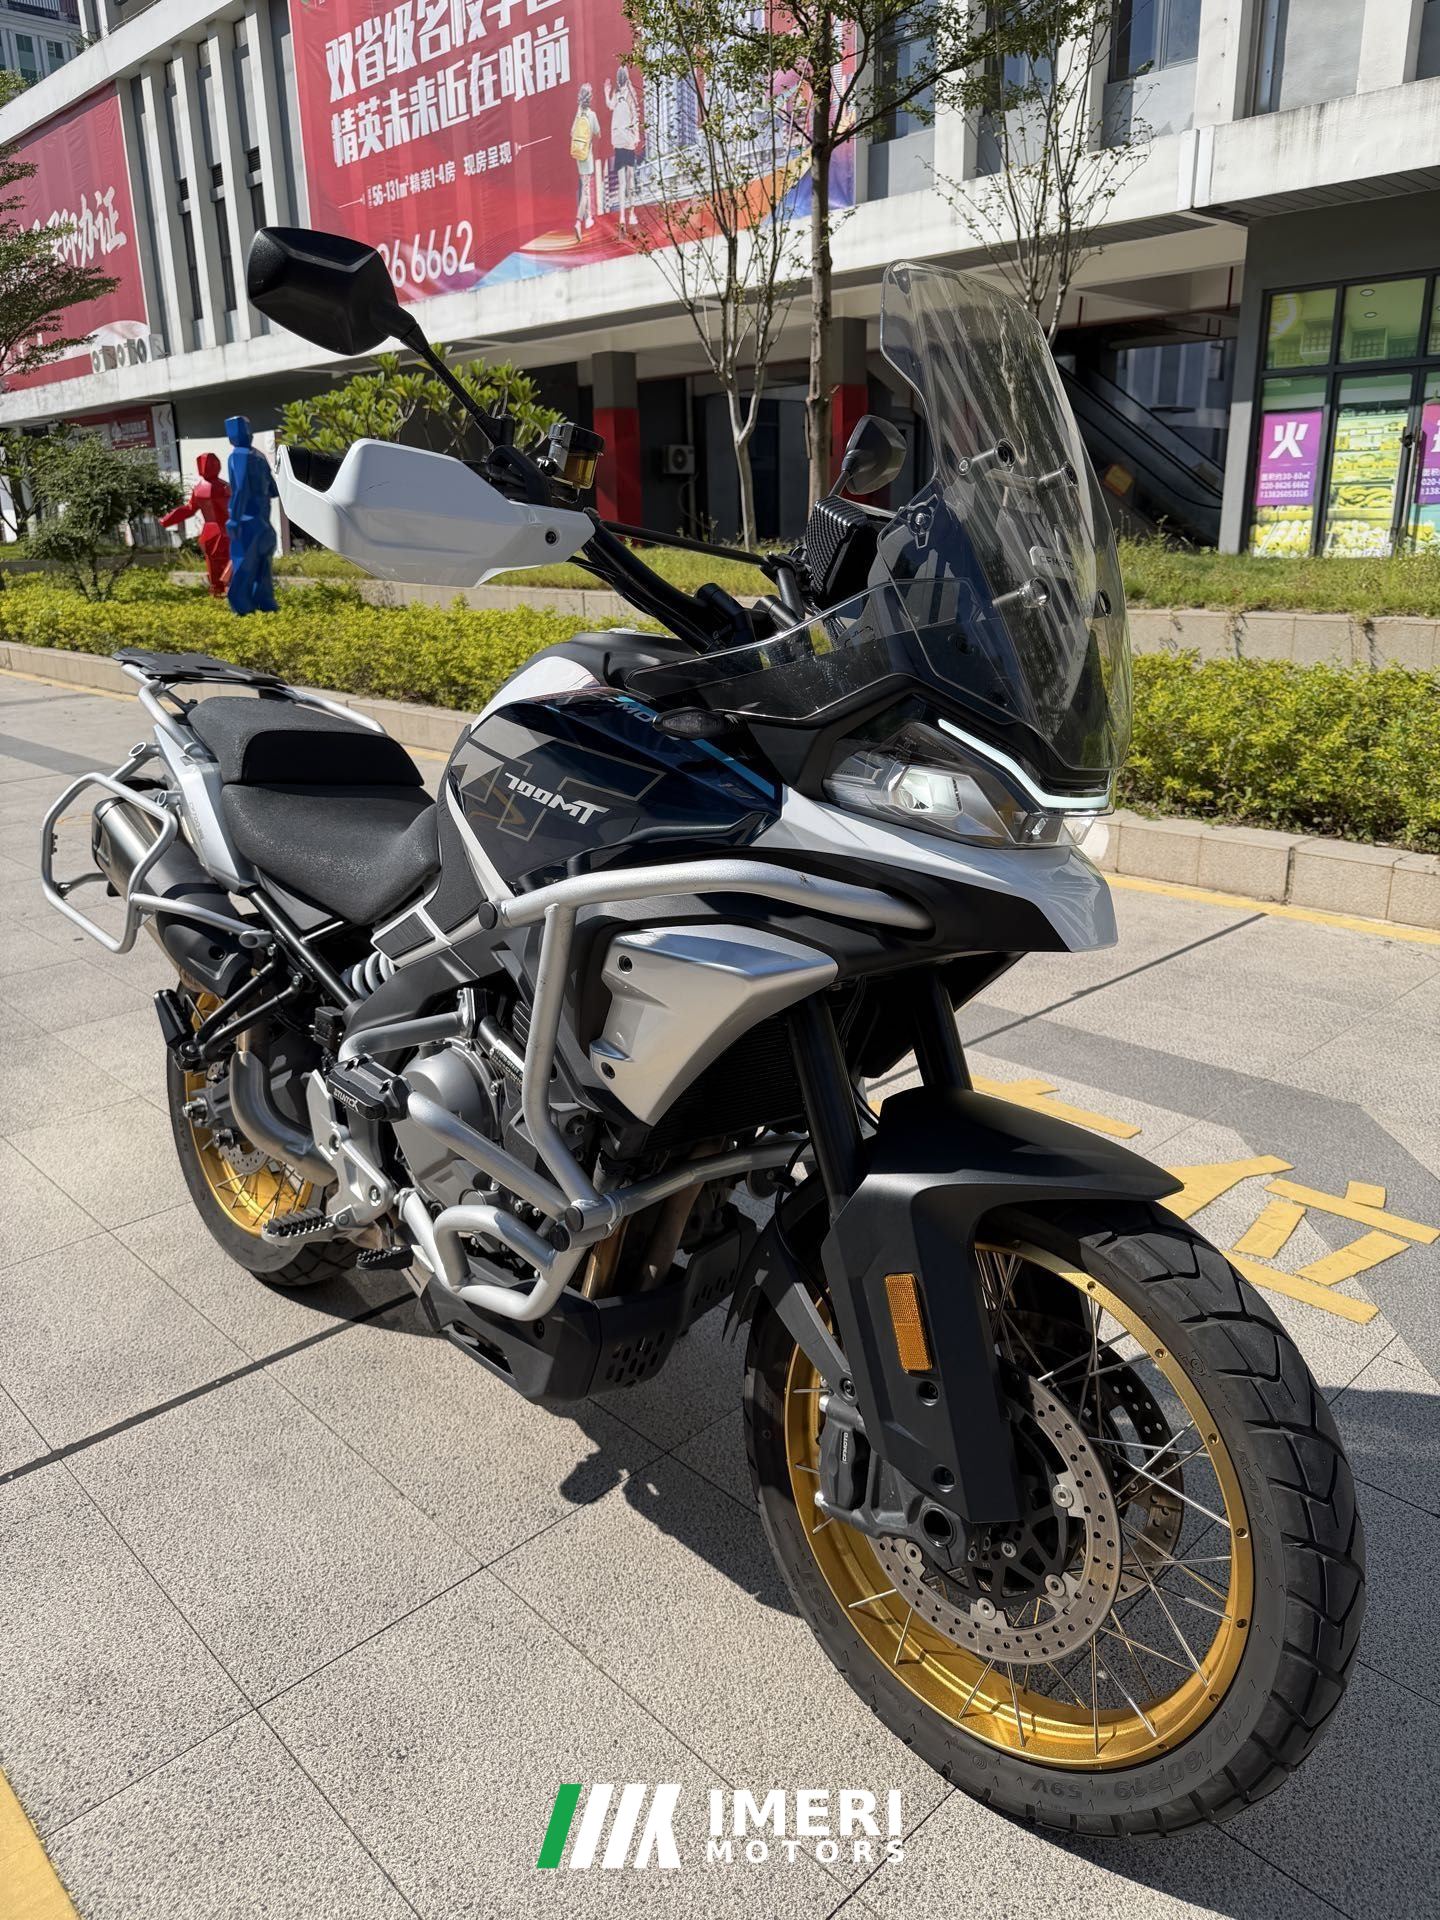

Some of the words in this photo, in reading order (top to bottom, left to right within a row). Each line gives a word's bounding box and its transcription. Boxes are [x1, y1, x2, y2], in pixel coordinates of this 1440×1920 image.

[325, 0, 562, 103] 双省级名校
[331, 16, 570, 168] 精英未来近在眼前
[463, 140, 513, 177] 现房呈现
[1268, 421, 1309, 459] 火
[504, 772, 610, 825] 700MT
